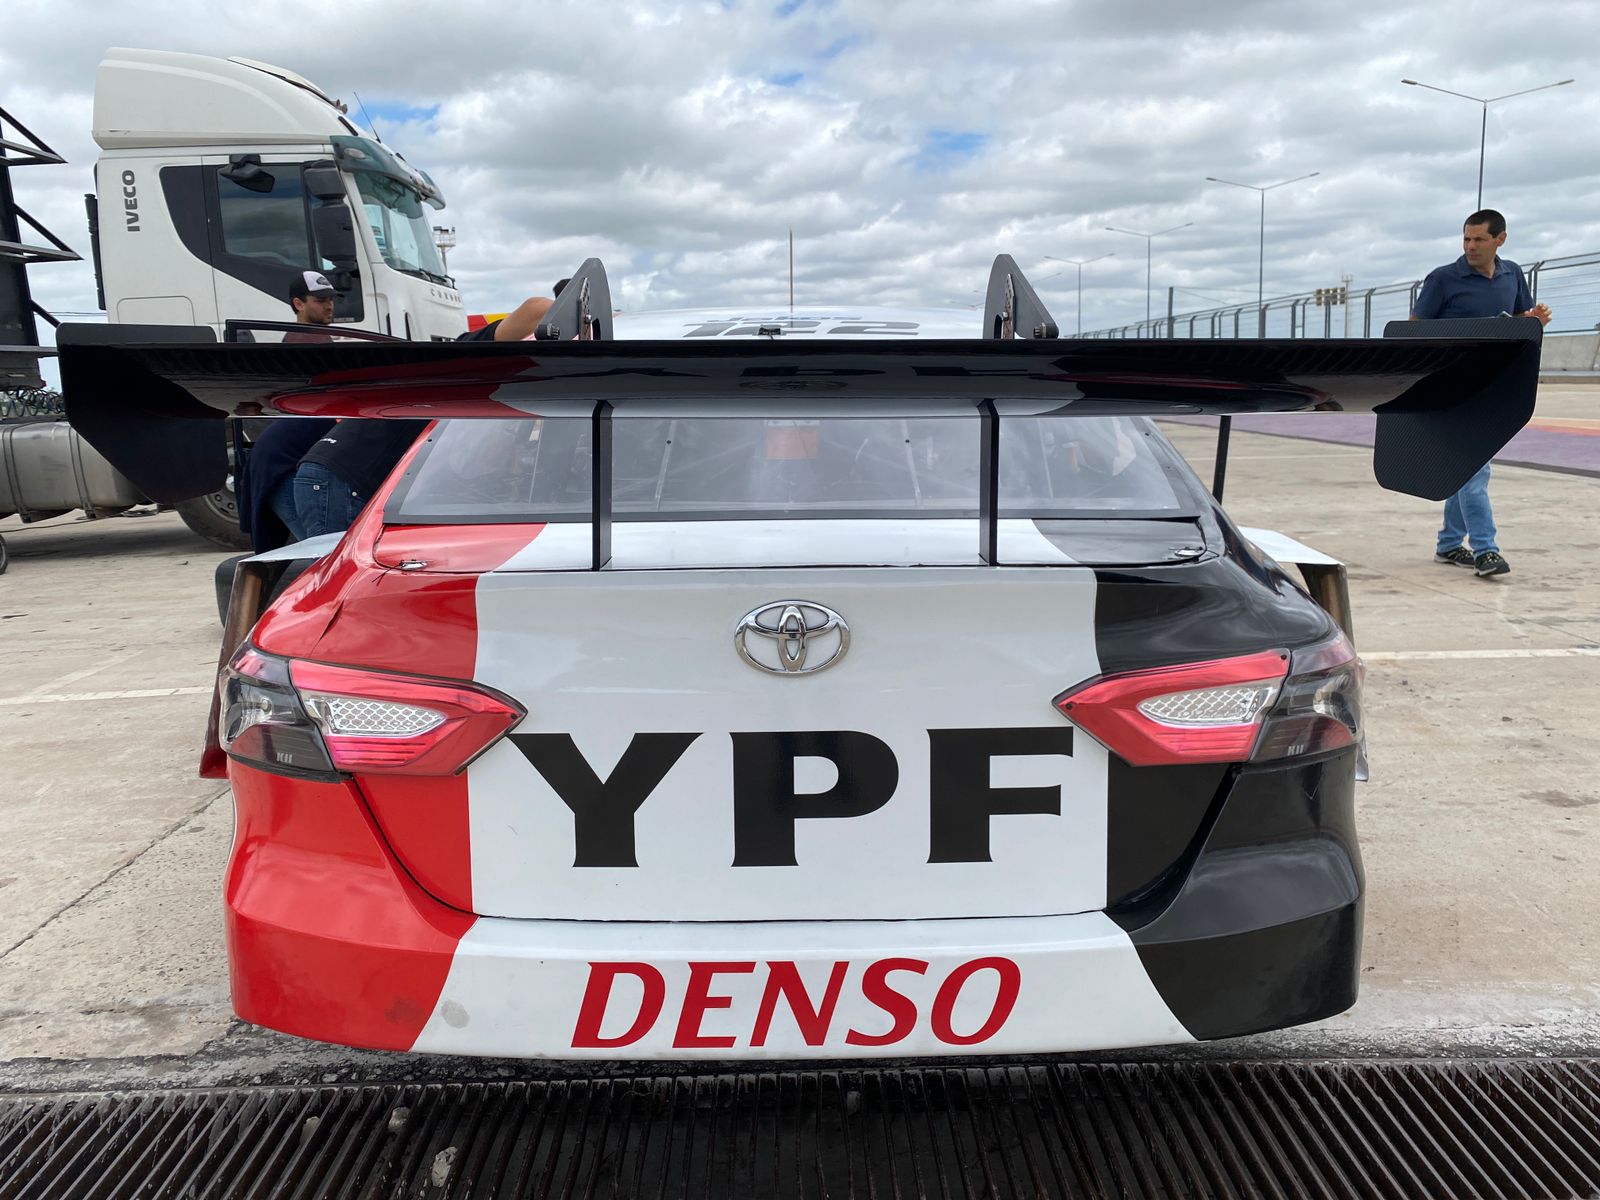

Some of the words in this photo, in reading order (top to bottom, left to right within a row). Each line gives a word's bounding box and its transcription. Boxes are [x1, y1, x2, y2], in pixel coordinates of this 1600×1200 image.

[121, 169, 141, 232] IVECO
[682, 320, 920, 338] 122
[508, 727, 1074, 868] YPF
[571, 956, 1022, 1049] DENSO
